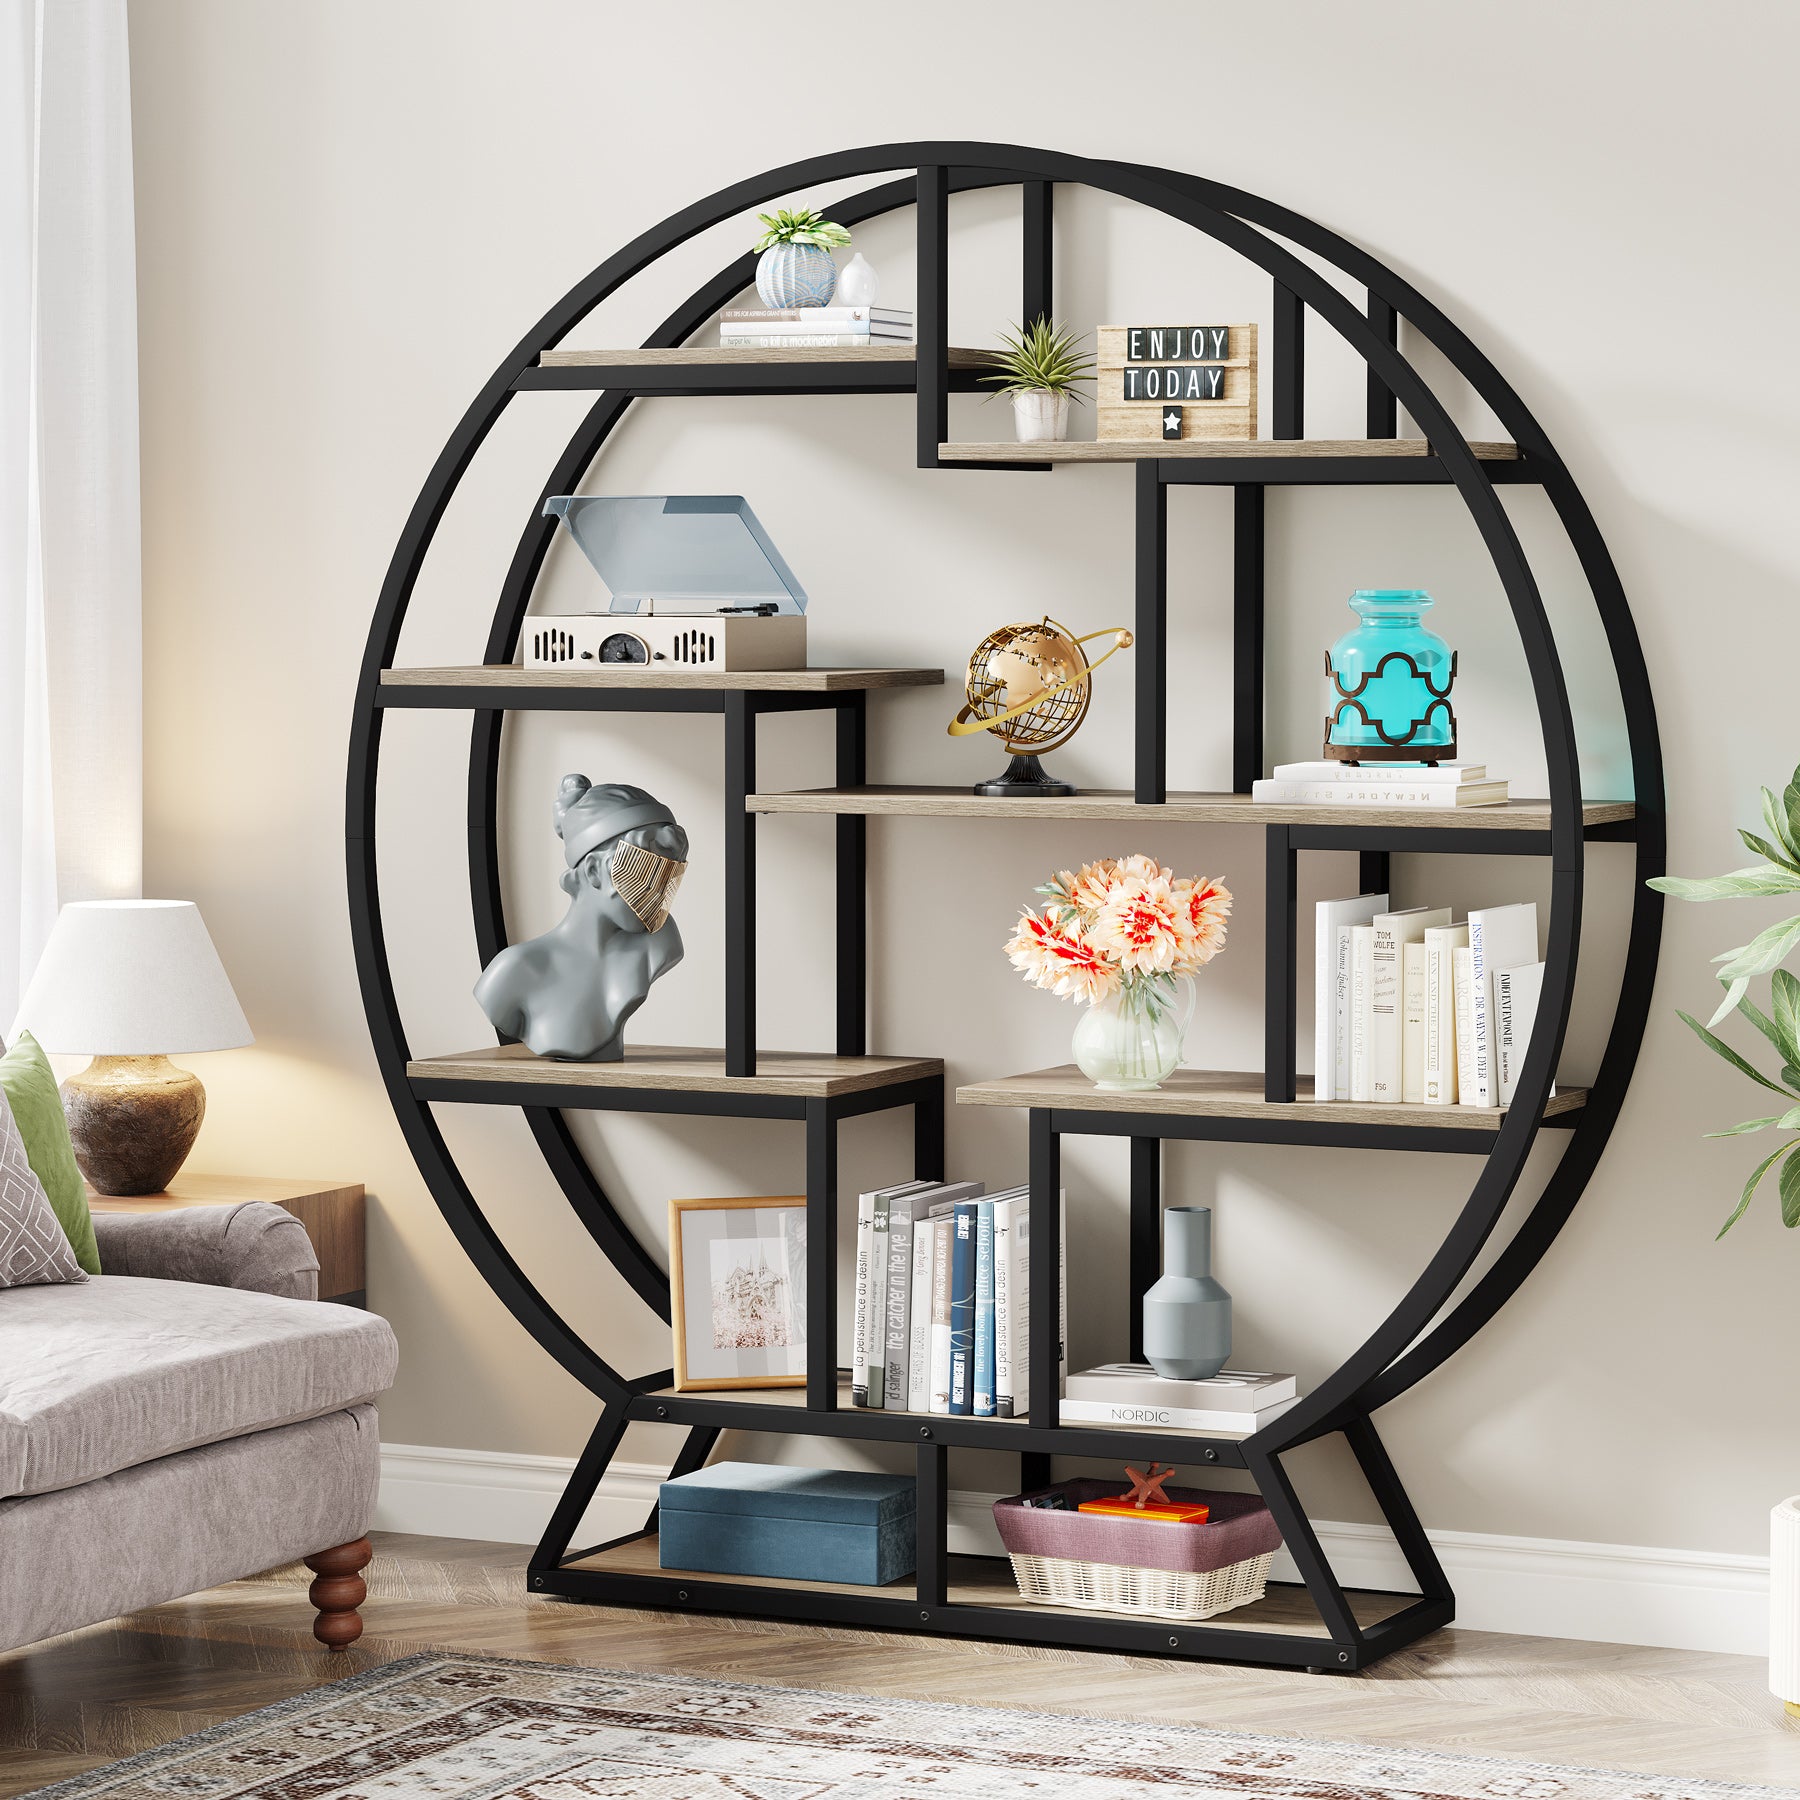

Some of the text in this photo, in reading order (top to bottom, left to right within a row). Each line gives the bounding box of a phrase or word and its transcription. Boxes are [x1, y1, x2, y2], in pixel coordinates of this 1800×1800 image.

[760, 337, 767, 346] to
[783, 338, 788, 346] a
[789, 335, 837, 346] mockingbird
[1131, 329, 1224, 359] ENJOY
[1127, 369, 1221, 398] TODAY
[1373, 941, 1395, 949] WOLFE
[1337, 935, 1349, 1000] Johanna Lindsey
[1354, 998, 1363, 1014] LET
[1456, 976, 1470, 1027] ARCTIC
[1472, 923, 1487, 1079] INSPIRATION DR. WAYNE W. DYER
[1501, 974, 1512, 1011] INDECENT
[1354, 1017, 1363, 1031] ME
[1502, 1011, 1512, 1046] EXPOSURE
[1354, 1033, 1363, 1056] LOVE
[1459, 1034, 1472, 1091] DREAMS
[1375, 1083, 1386, 1091] FSG
[916, 1256, 927, 1268] Greg
[887, 1234, 911, 1349] the catcher in the rye
[976, 1216, 990, 1373] the lovely bones alice sebold
[856, 1251, 869, 1367] La persistance du destin
[995, 1259, 1012, 1377] La persistance du destin
[913, 1326, 924, 1350] GLASSES
[886, 1361, 902, 1401] jd salinger
[912, 1360, 922, 1375] PAIRS
[911, 1377, 921, 1392] THREE
[1111, 1408, 1170, 1424] NORDIC
